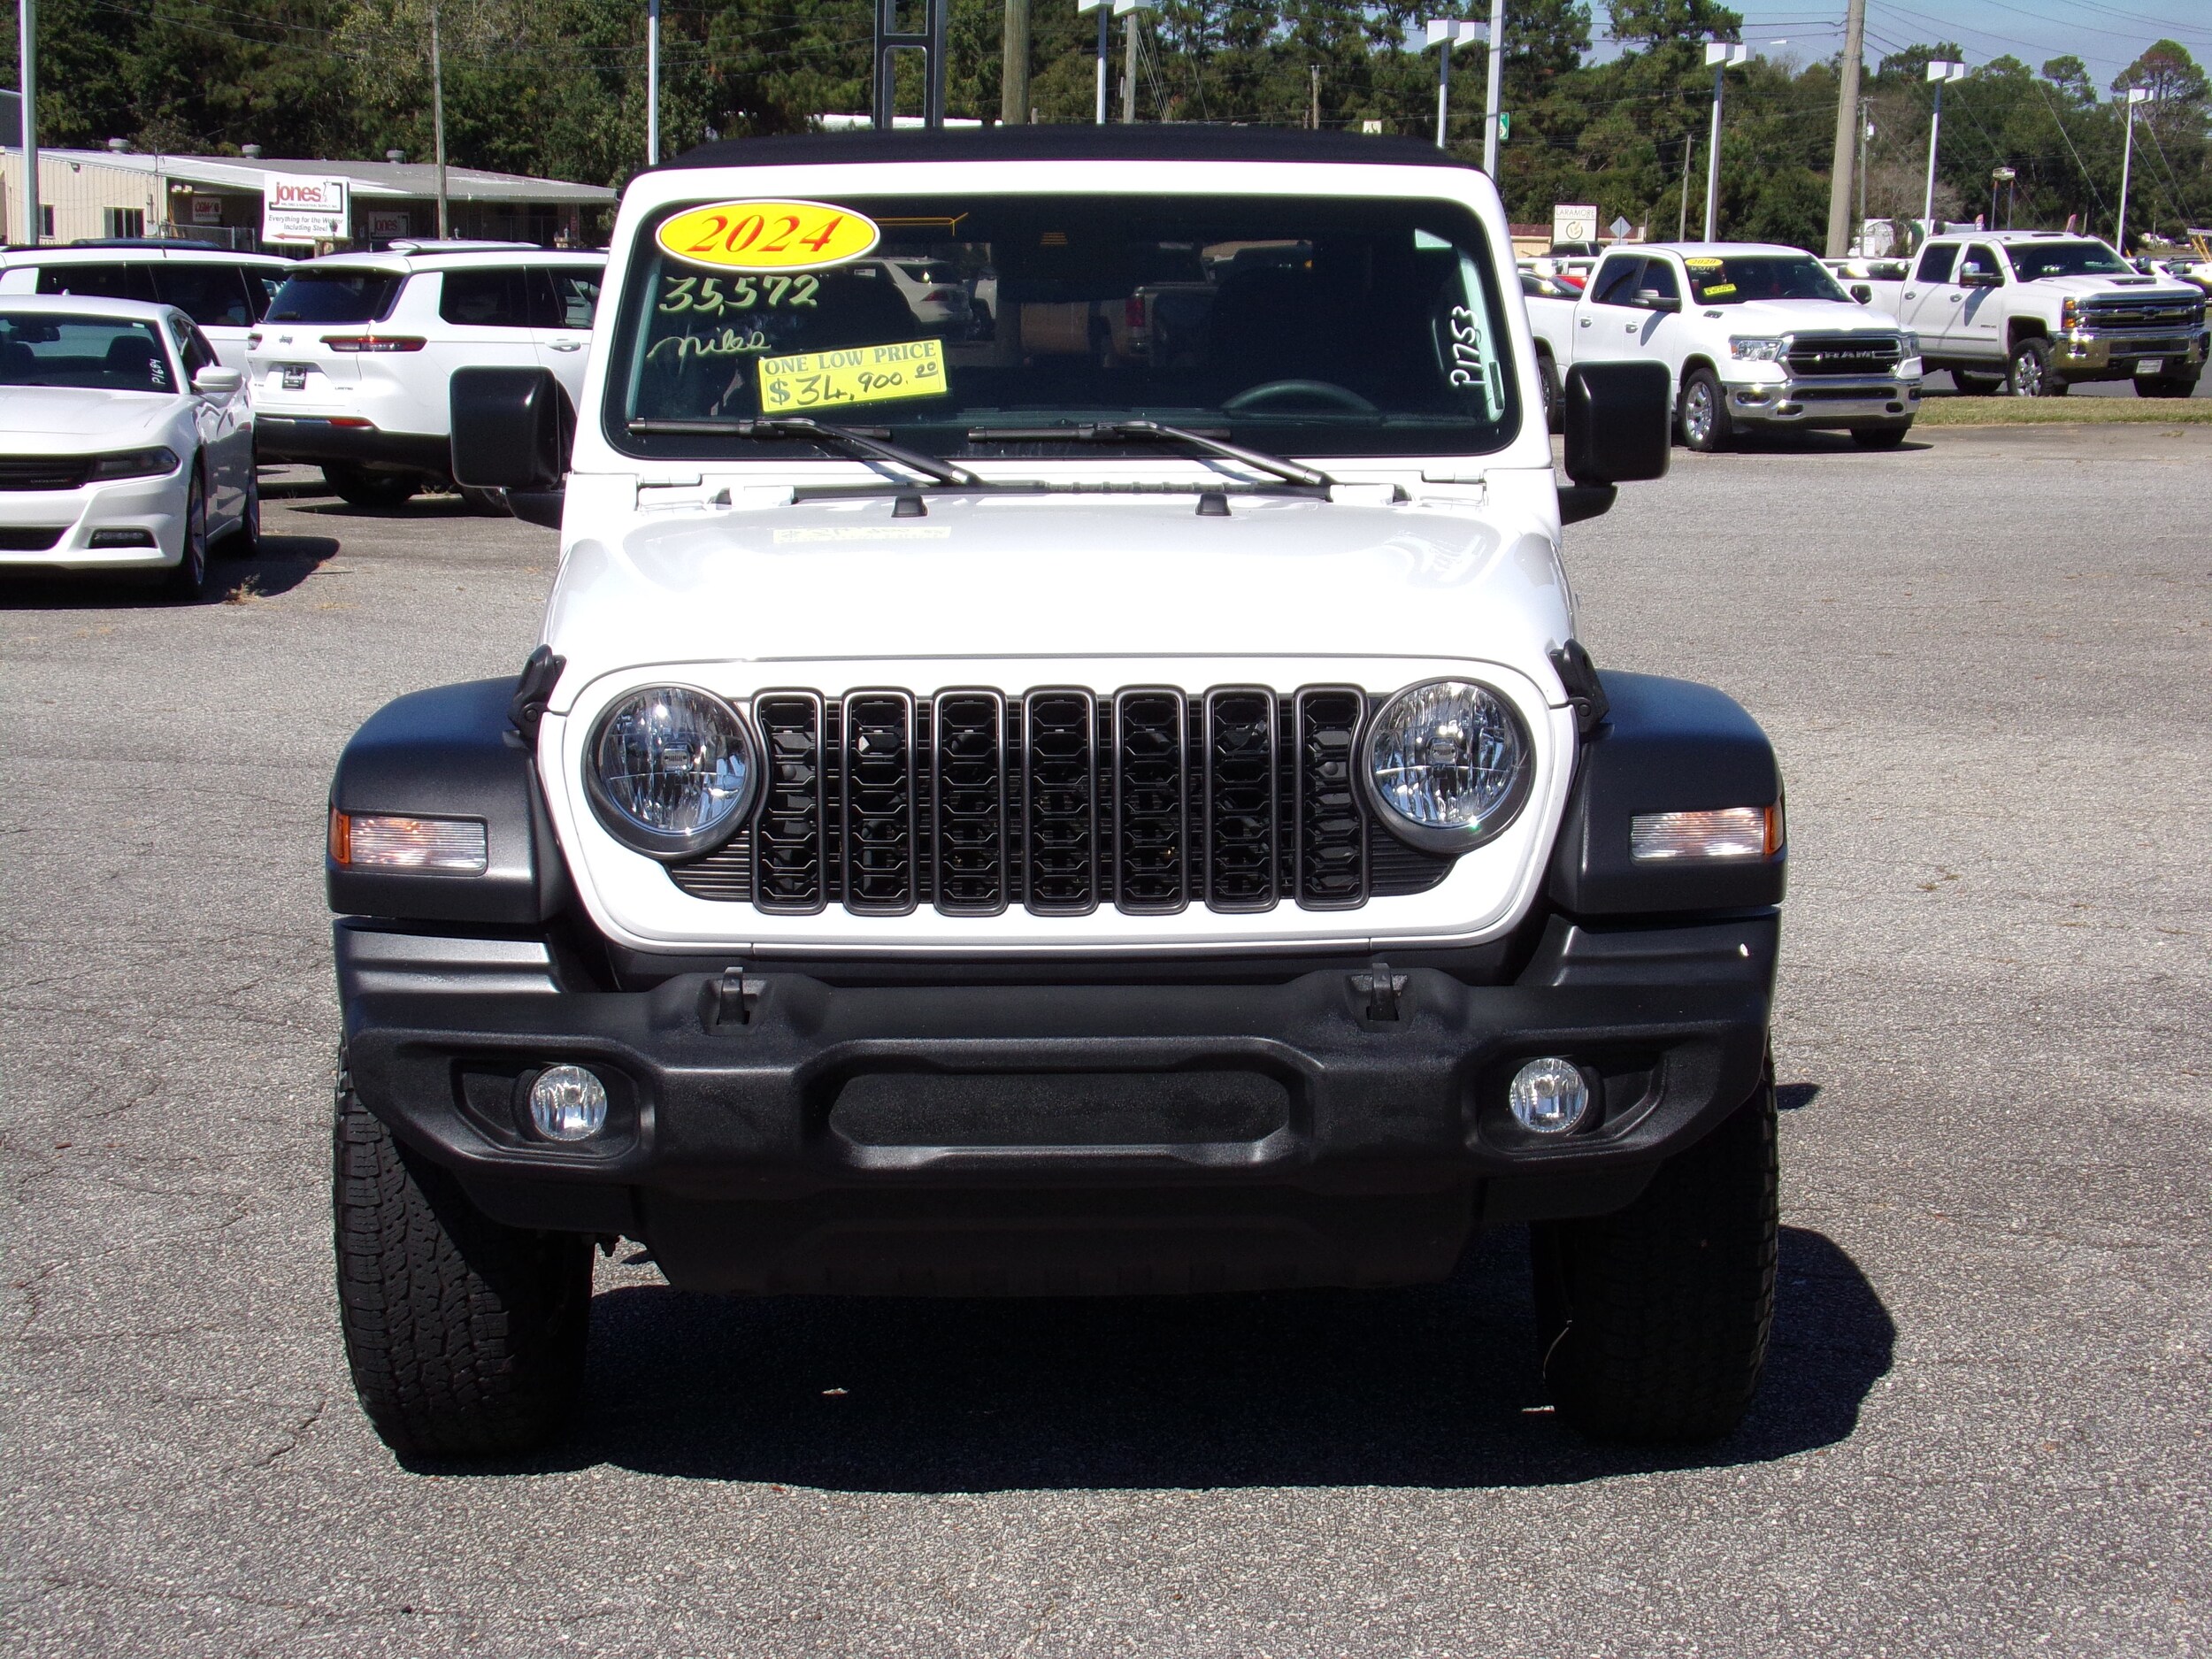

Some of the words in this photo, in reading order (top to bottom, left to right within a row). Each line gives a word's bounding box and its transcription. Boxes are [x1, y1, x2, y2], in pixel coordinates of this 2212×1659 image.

[273, 181, 321, 205] jones
[268, 214, 300, 224] Everything
[284, 223, 311, 233] Including
[685, 214, 843, 253] 2024
[658, 273, 820, 317] 35,572
[764, 357, 809, 376] ONE
[818, 349, 864, 369] LOW
[873, 342, 937, 364] PRICE
[1824, 350, 1871, 359] RAM
